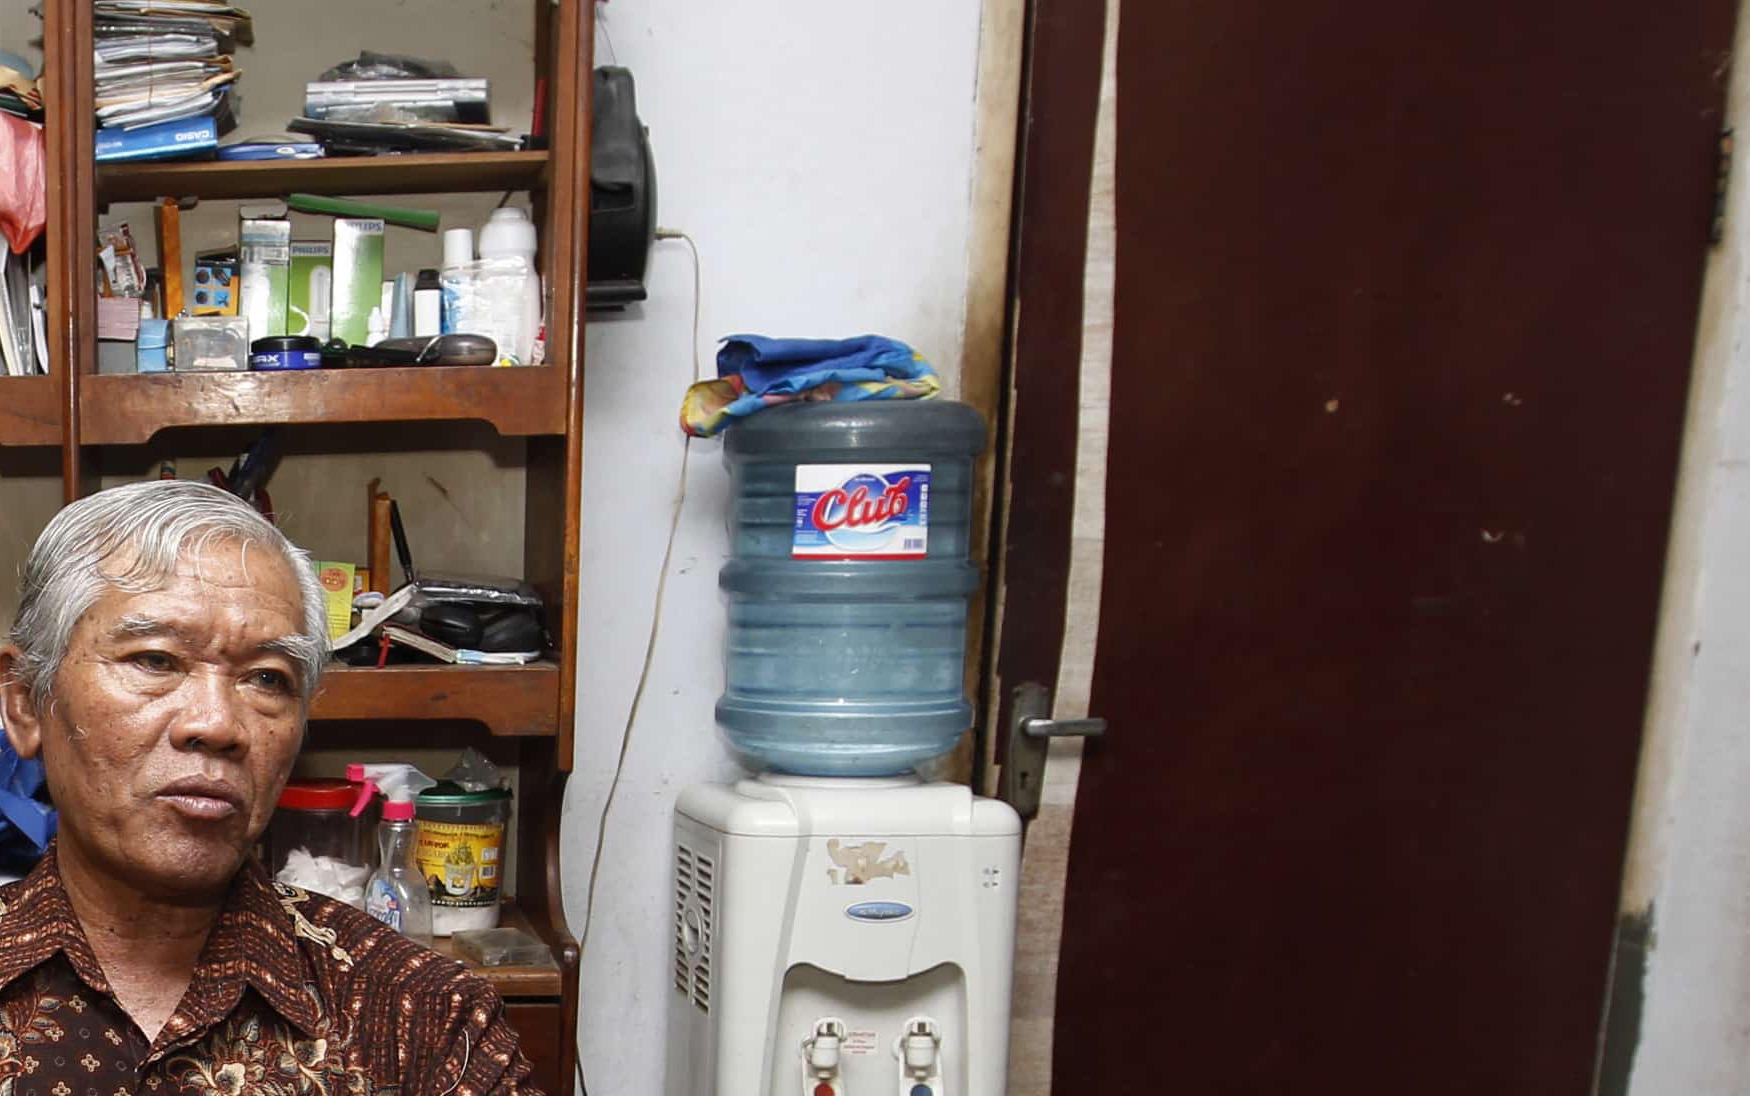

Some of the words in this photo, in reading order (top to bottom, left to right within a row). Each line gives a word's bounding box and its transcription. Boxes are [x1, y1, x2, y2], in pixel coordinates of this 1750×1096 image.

[175, 129, 210, 142] CASIO
[292, 244, 329, 255] PHILIPS
[812, 476, 911, 532] Club
